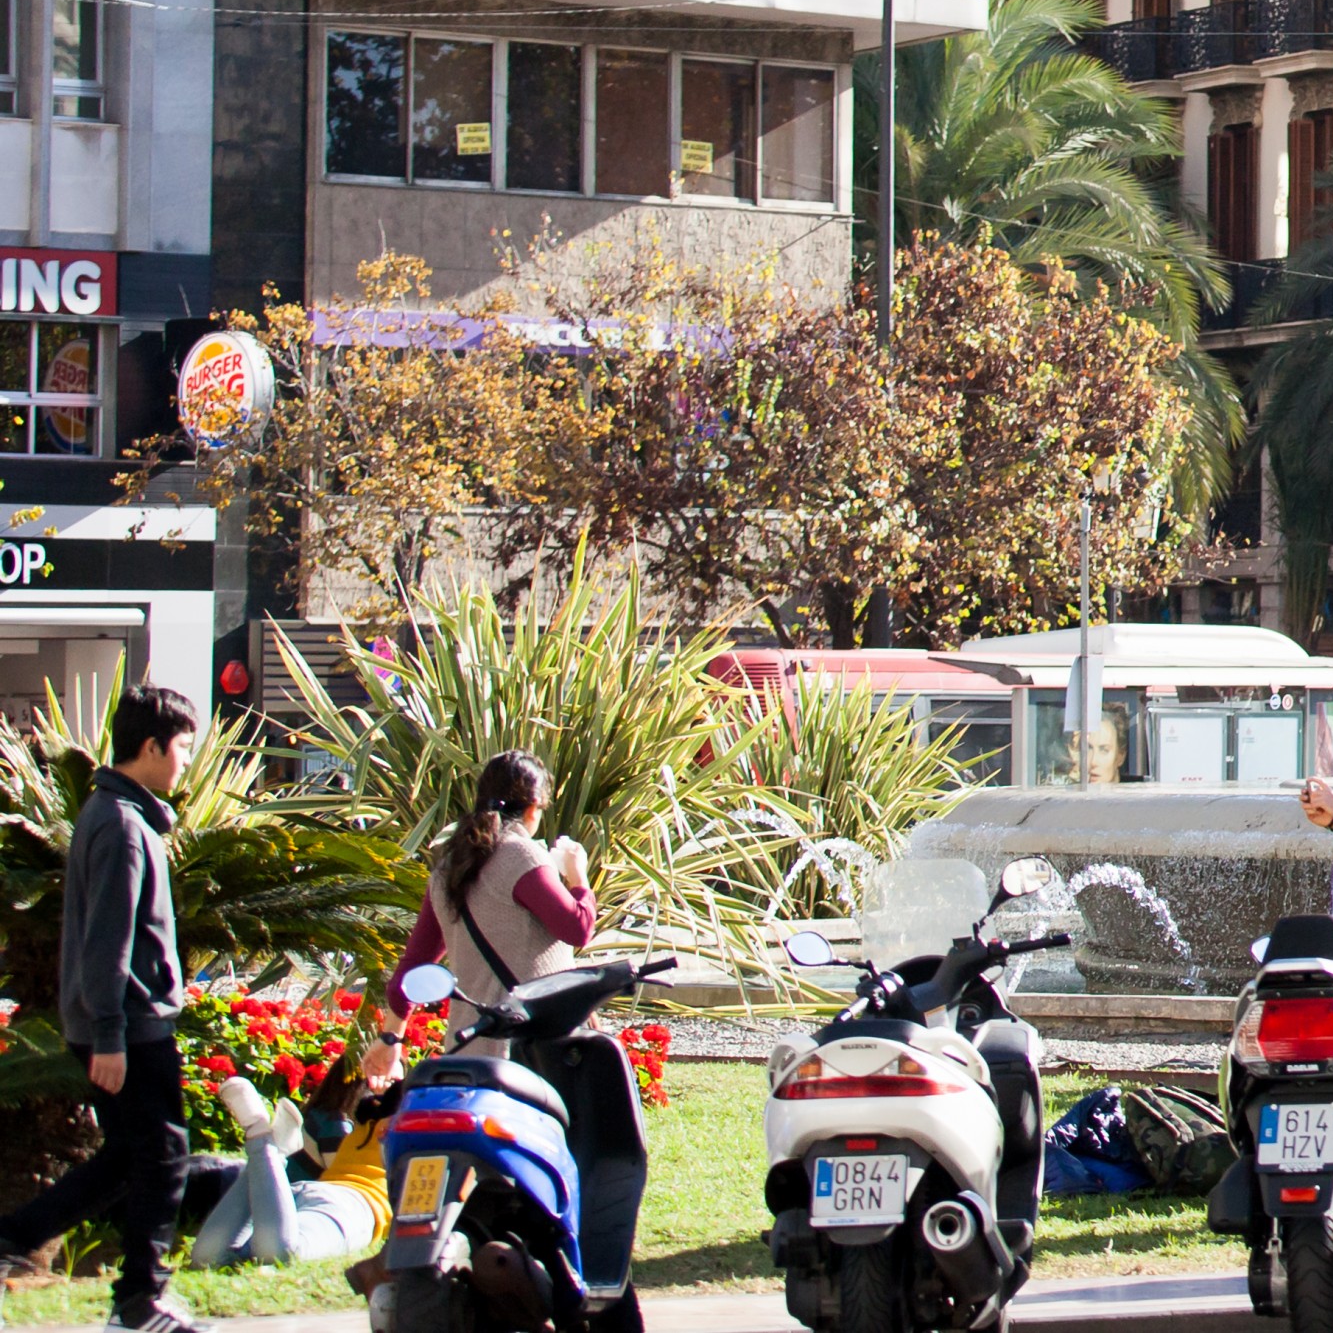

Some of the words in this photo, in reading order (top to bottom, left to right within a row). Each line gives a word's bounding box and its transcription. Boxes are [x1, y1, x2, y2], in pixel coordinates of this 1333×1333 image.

[0, 257, 101, 315] ING
[187, 353, 242, 392] BURGER
[1282, 1135, 1327, 1158] HZV
[835, 1160, 900, 1185] 0844
[834, 1186, 883, 1212] GRN
